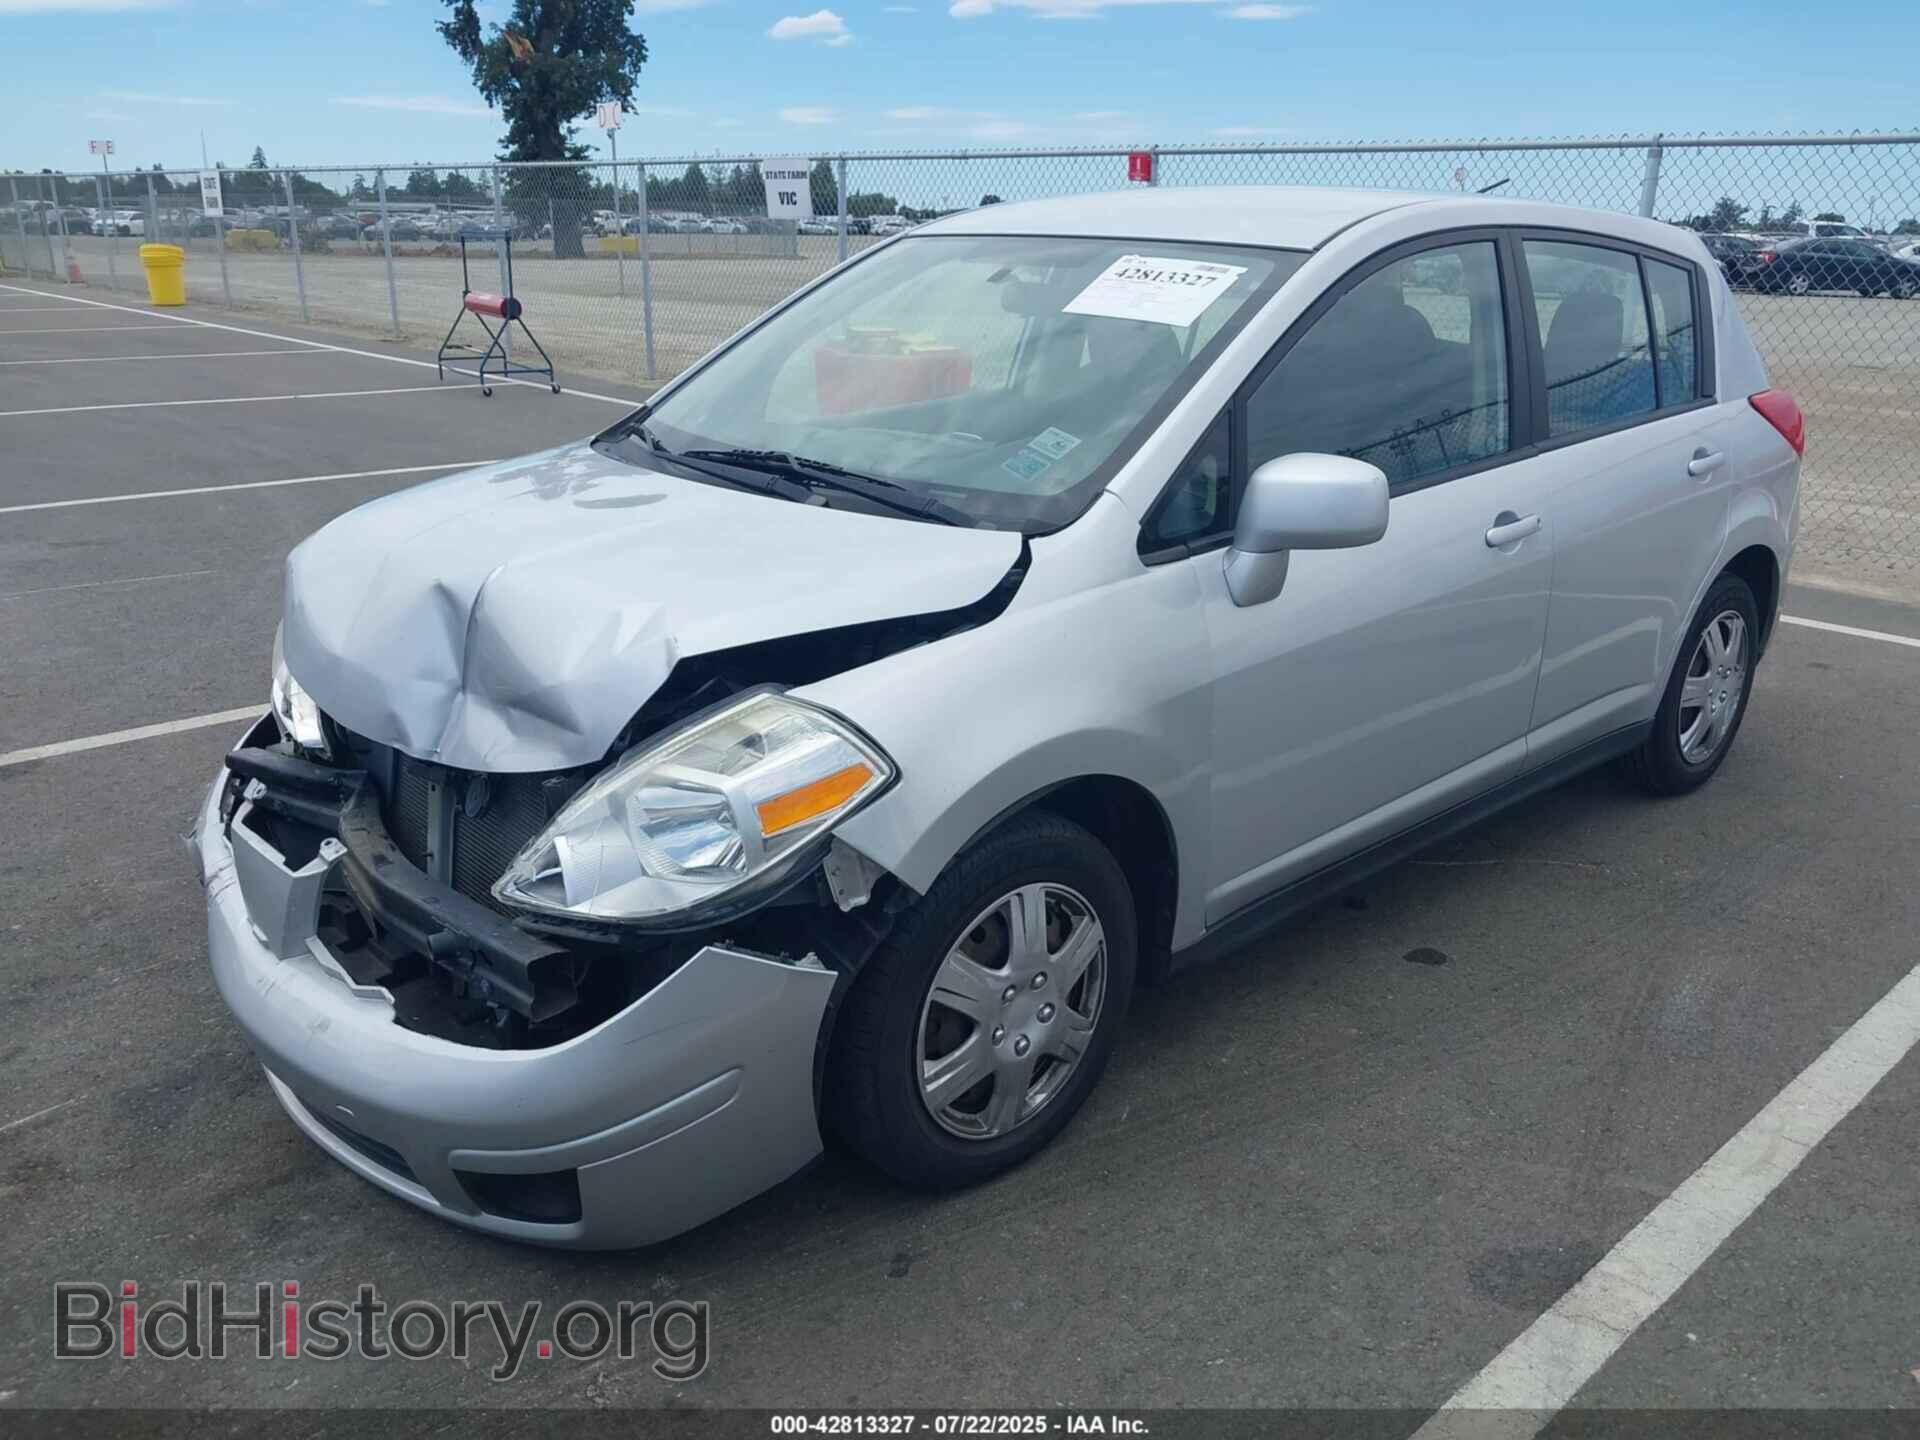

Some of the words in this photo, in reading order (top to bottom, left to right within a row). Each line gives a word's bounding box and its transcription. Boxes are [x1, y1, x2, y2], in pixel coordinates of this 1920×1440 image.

[765, 170, 787, 180] STATE
[787, 170, 808, 180] FARM
[778, 191, 798, 206] VIC
[1115, 267, 1218, 288] 42813327
